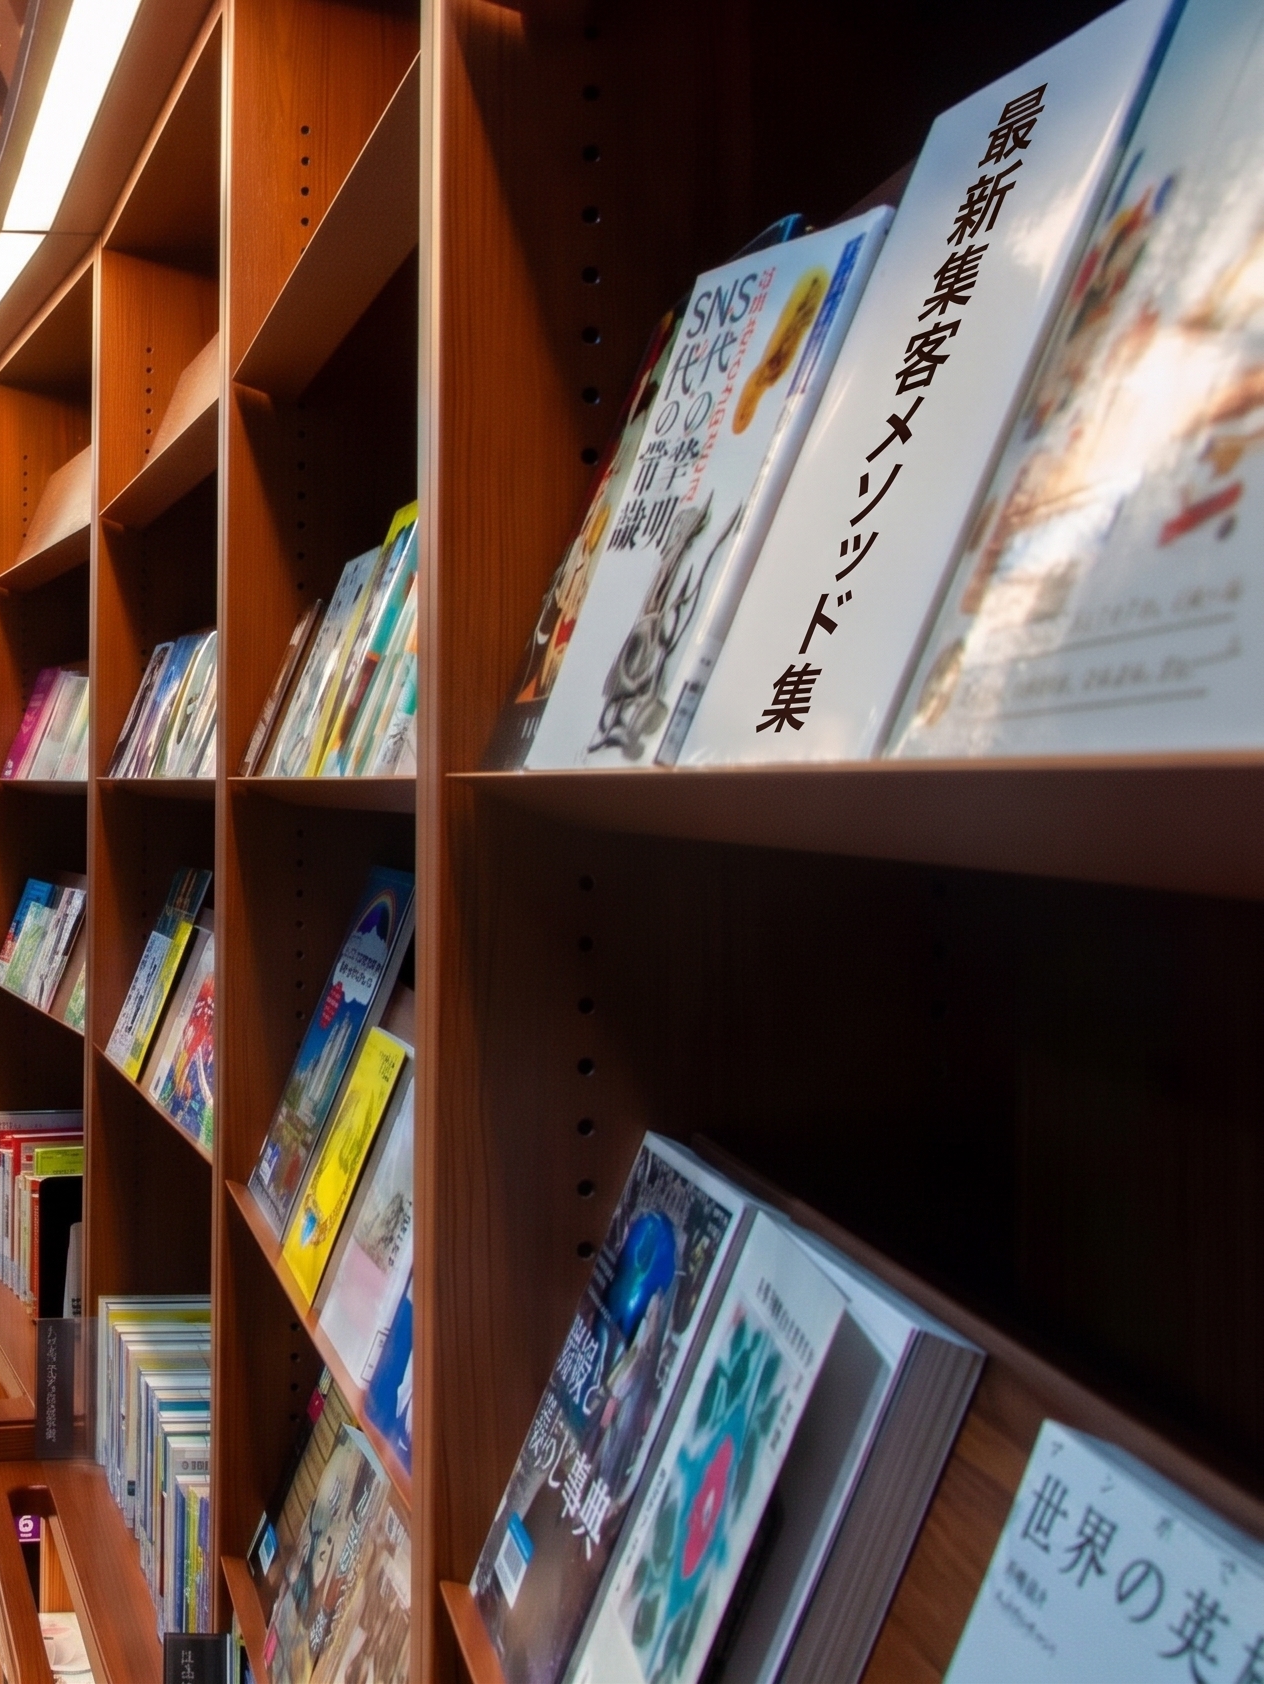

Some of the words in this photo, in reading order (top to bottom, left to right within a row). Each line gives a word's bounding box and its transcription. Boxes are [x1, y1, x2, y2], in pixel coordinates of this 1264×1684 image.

[686, 273, 758, 339] SNS
[755, 82, 1048, 733] 最新集客メソッド集
